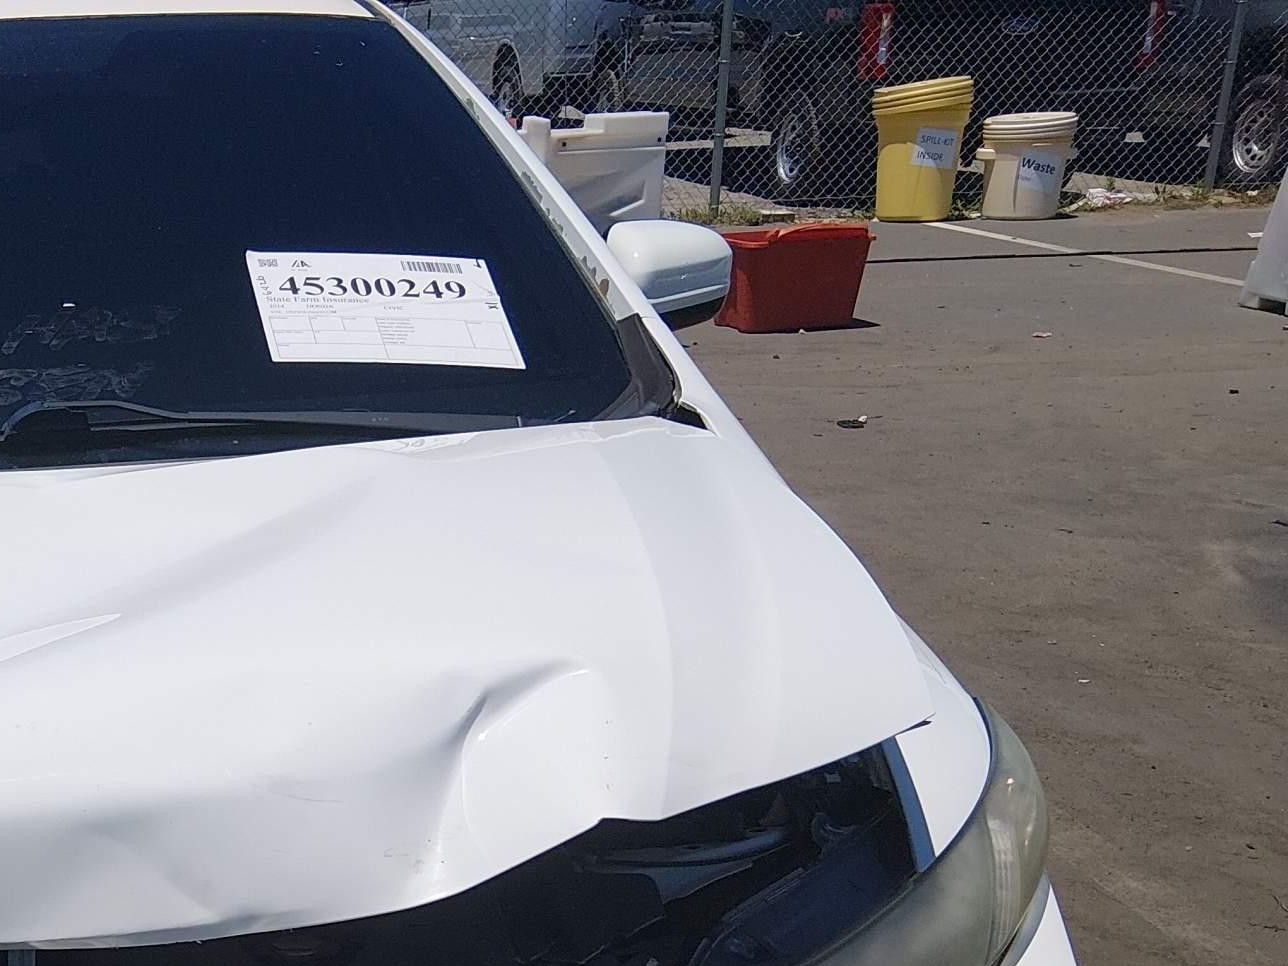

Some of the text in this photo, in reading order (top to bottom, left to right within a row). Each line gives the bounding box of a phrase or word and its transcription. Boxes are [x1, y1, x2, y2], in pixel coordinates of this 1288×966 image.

[917, 150, 945, 161] INSIDE
[1022, 157, 1056, 175] Waste
[278, 276, 467, 299] 45300249
